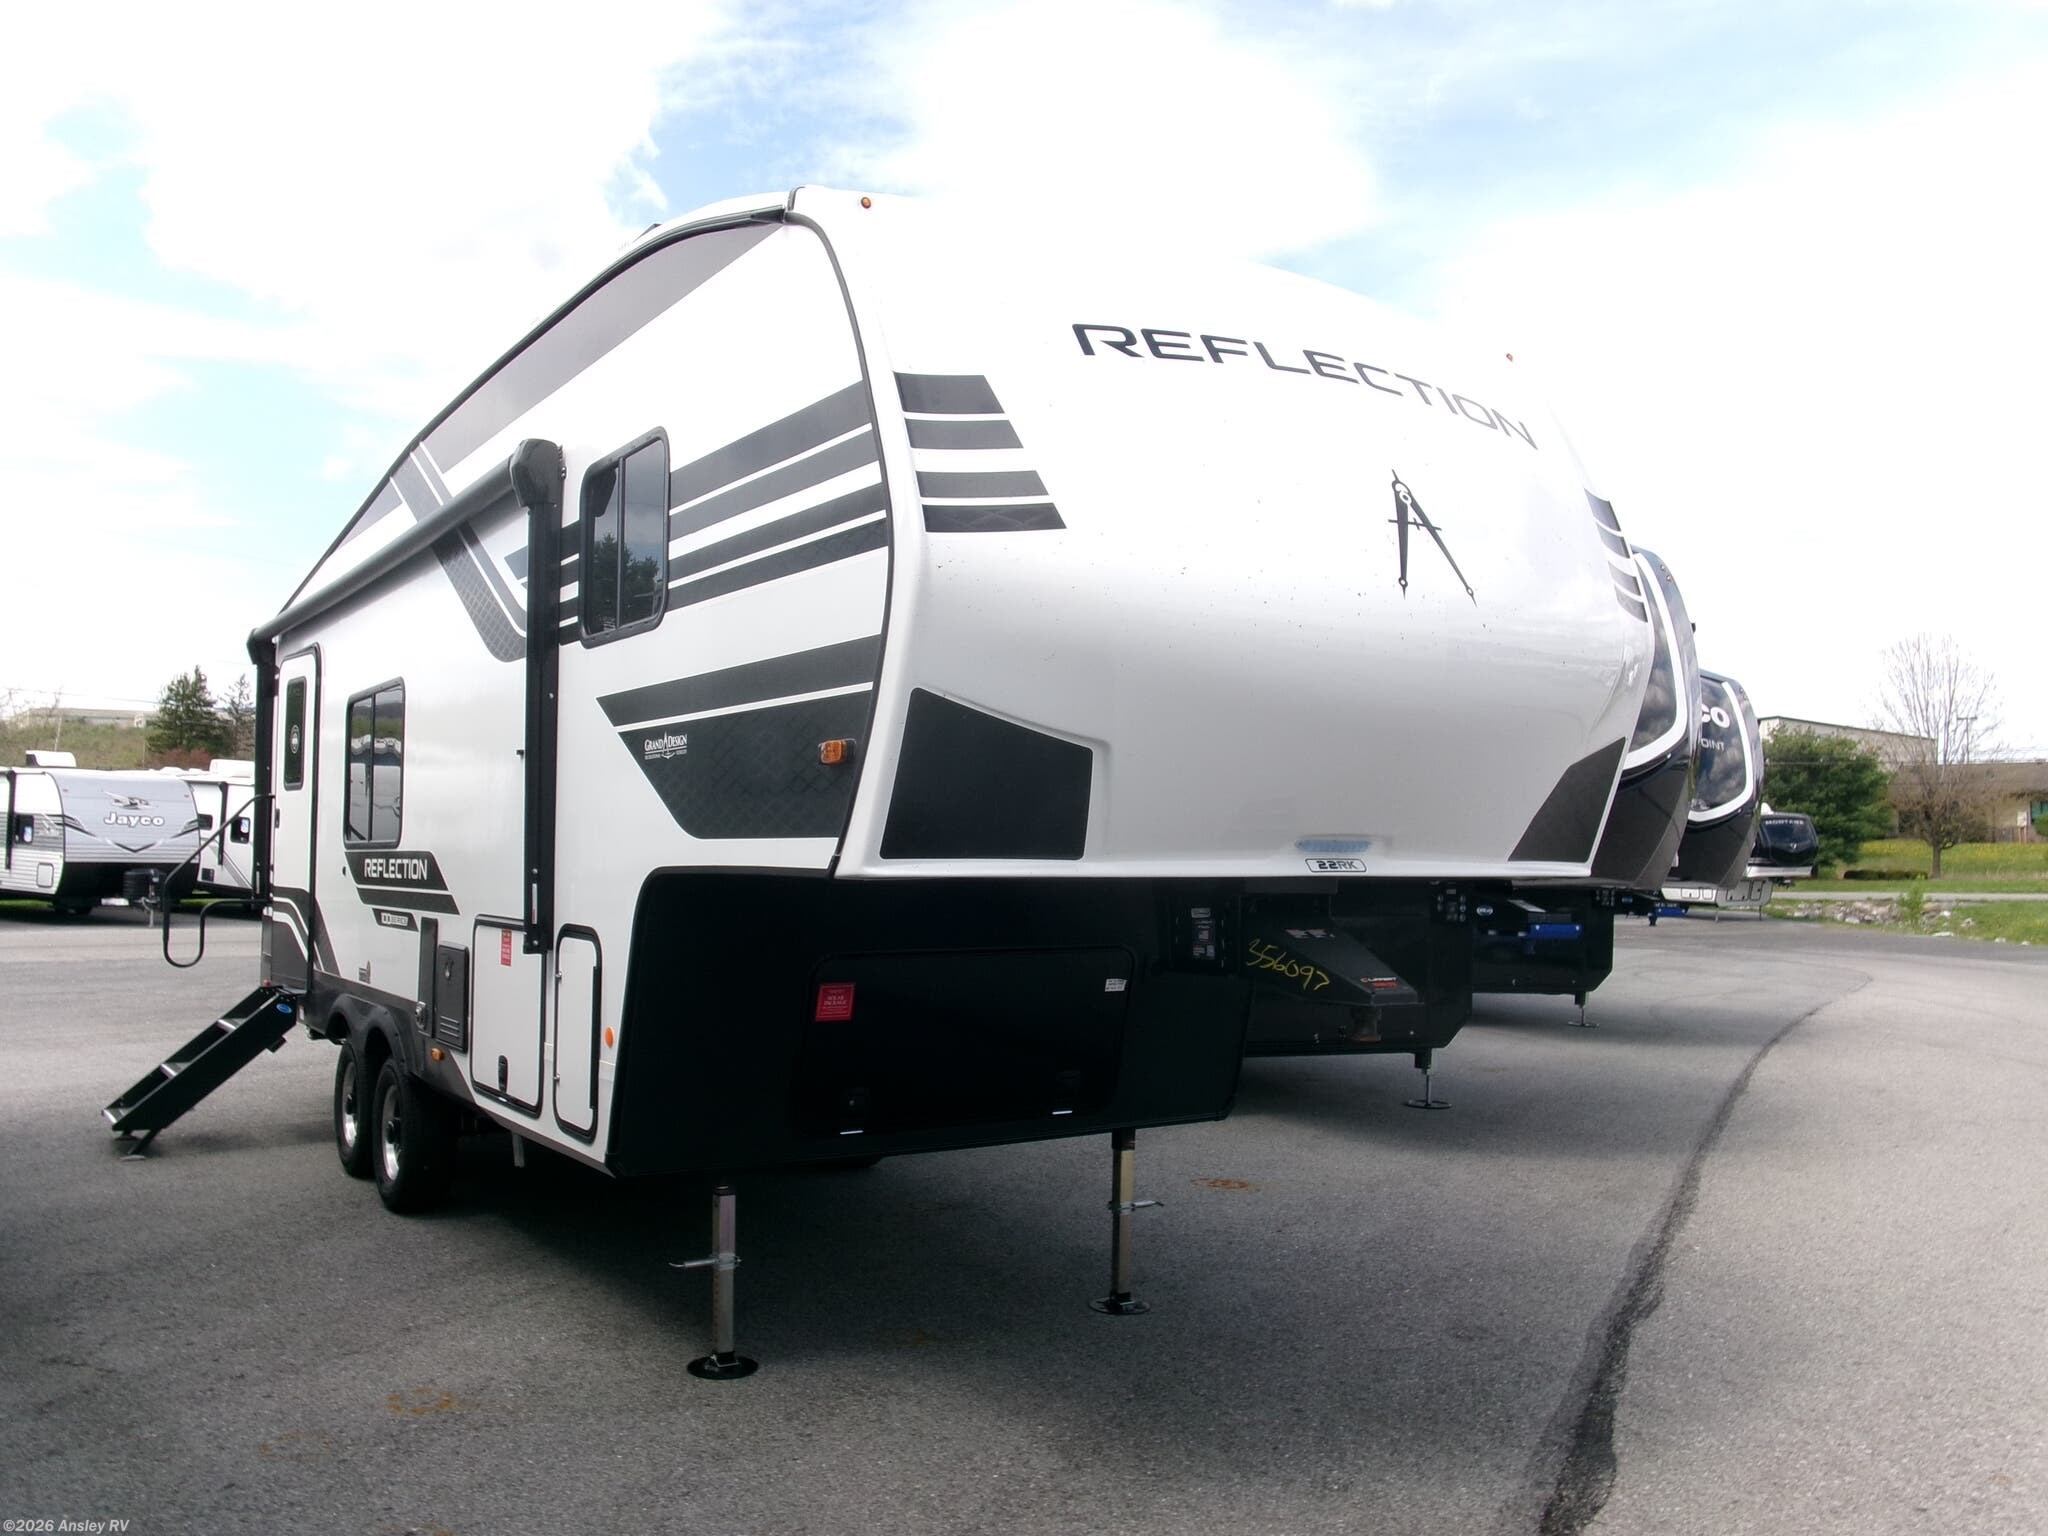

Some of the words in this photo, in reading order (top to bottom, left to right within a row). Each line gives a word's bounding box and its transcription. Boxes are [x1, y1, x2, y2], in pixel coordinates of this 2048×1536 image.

[1072, 323, 1538, 450] REFLECTION
[644, 738, 664, 751] GRAND
[667, 733, 687, 748] DESIGN
[104, 811, 165, 828] Jayco
[364, 858, 428, 880] REFLECTION
[1316, 860, 1358, 870] 22RK
[1246, 938, 1330, 990] 356097
